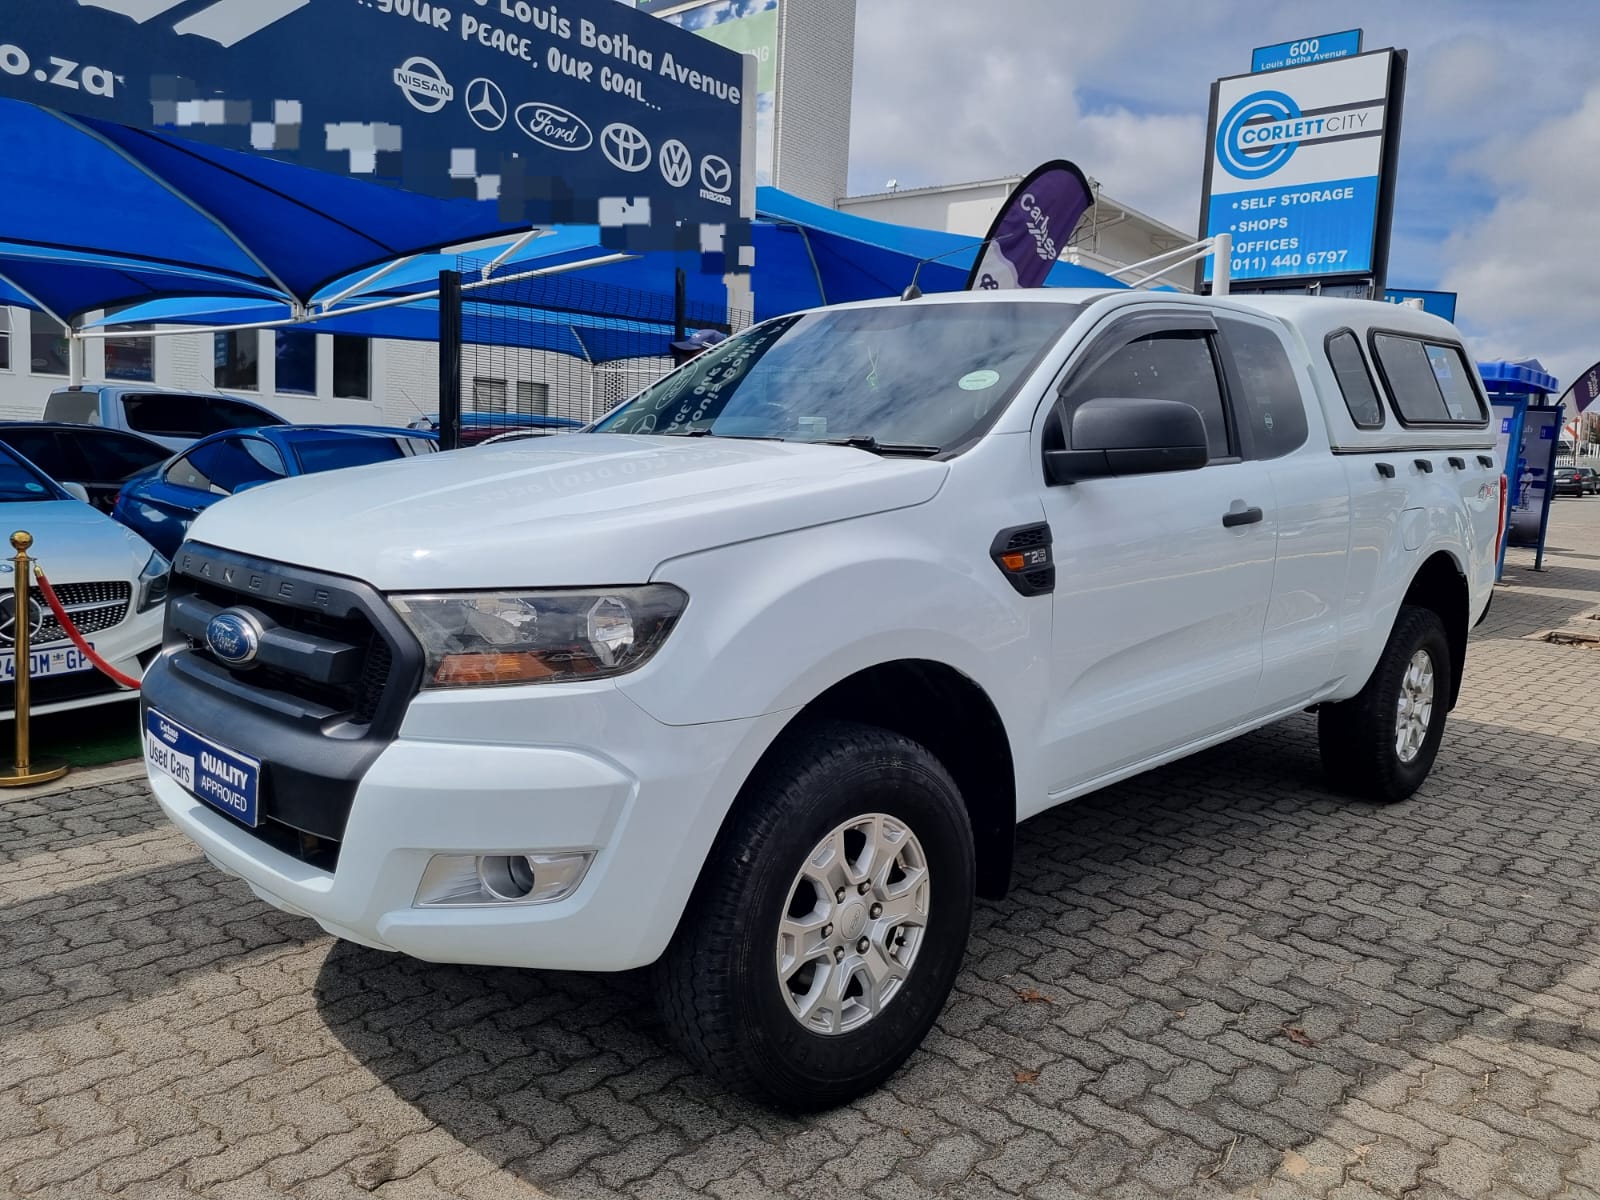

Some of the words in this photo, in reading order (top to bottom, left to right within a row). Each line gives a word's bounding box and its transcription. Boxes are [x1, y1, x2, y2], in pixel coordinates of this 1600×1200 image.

[500, 0, 572, 40] Louis
[580, 18, 652, 71] Botha
[659, 52, 741, 105] Avenue
[1261, 58, 1284, 71] Louis
[1285, 53, 1312, 66] Botha
[1313, 48, 1348, 62] Avenue
[1289, 39, 1320, 57] 600
[547, 47, 593, 83] OUR
[397, 72, 450, 97] NISSAN
[530, 109, 580, 145] Ford
[1240, 196, 1277, 211] SELF
[1280, 187, 1355, 207] STORAGE
[1238, 216, 1289, 233] SHOPS
[1236, 237, 1299, 254] OFFICES
[1271, 252, 1301, 268] 440
[1306, 249, 1348, 264] 6797
[182, 554, 330, 606] RANGER
[149, 738, 168, 769] Used
[170, 751, 190, 784] Cars
[201, 751, 249, 790] QUALITY
[201, 775, 248, 813] APPROVED
